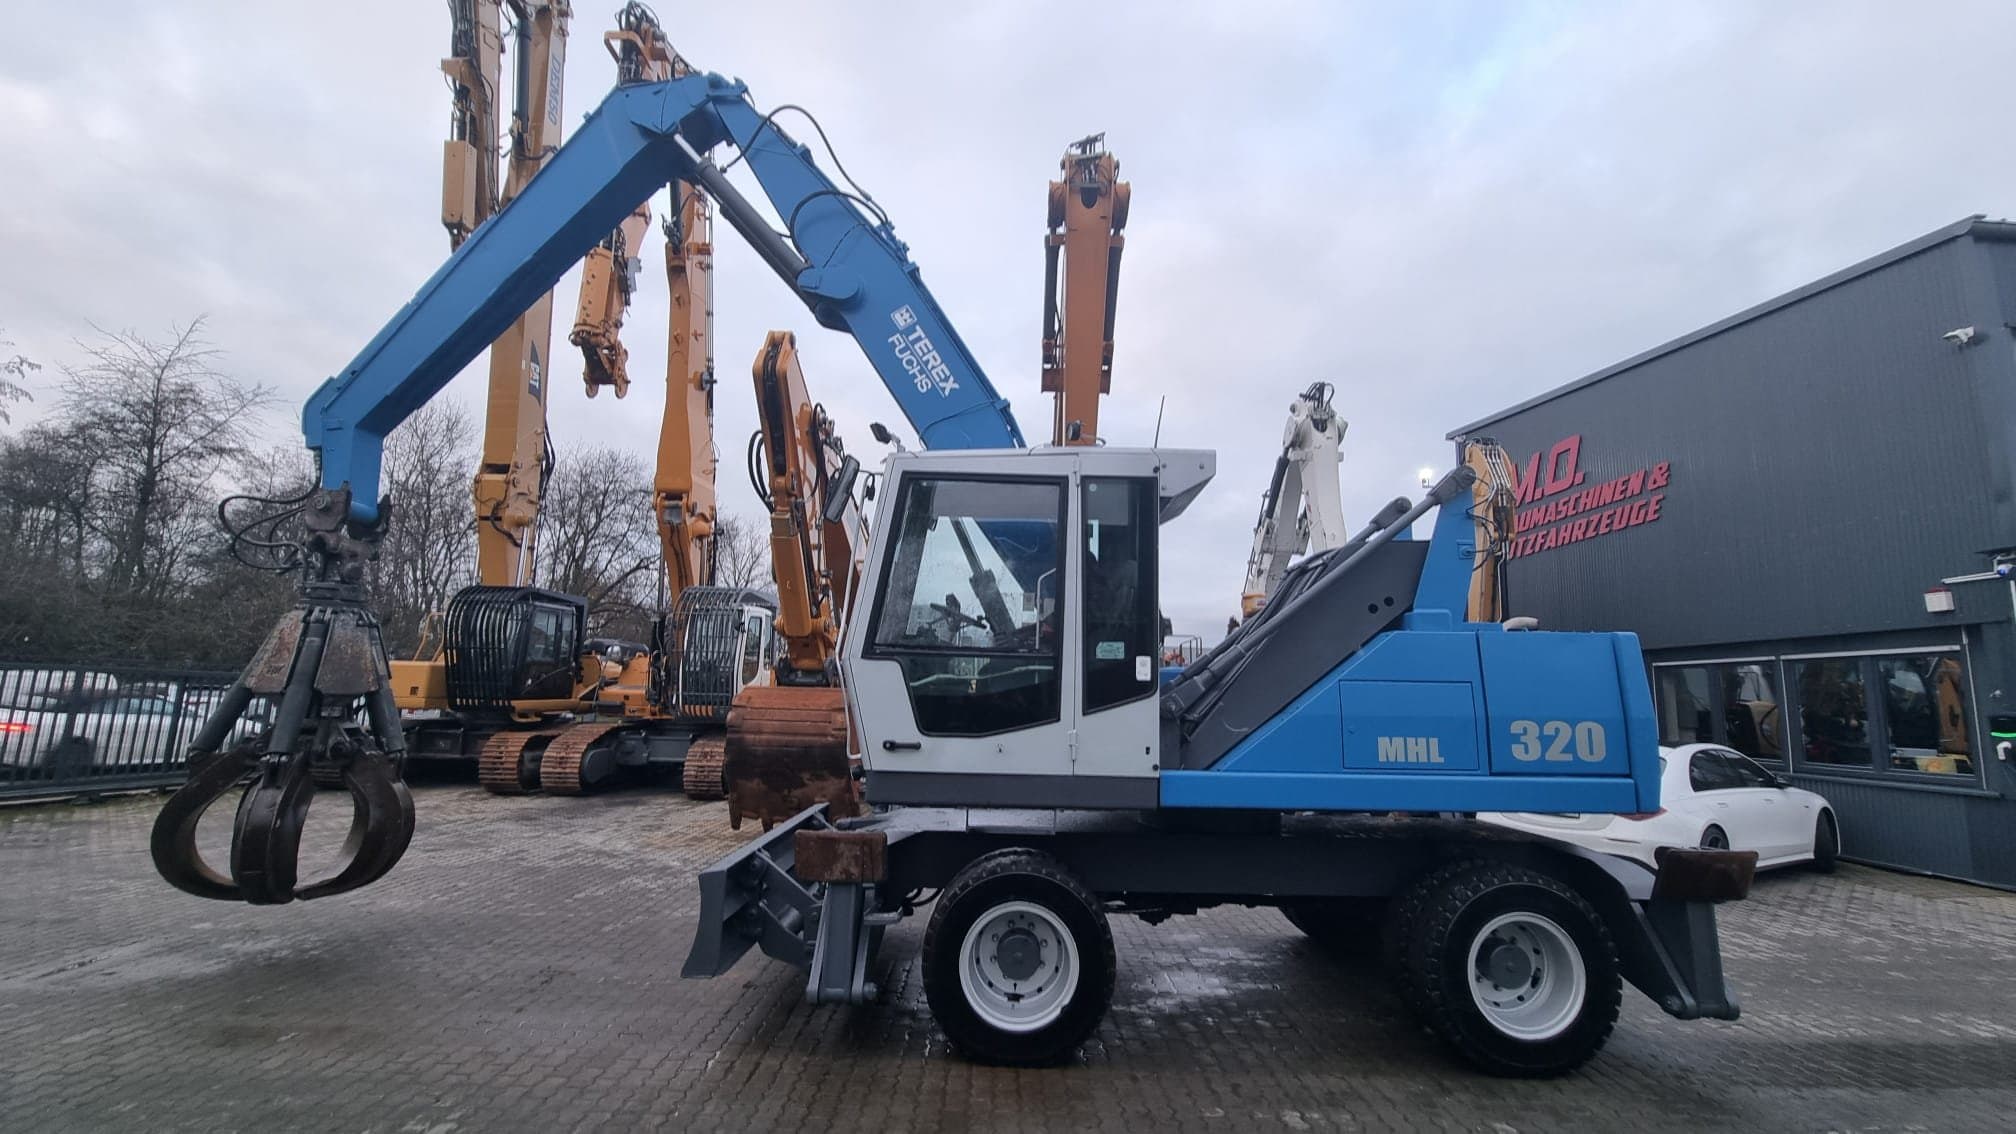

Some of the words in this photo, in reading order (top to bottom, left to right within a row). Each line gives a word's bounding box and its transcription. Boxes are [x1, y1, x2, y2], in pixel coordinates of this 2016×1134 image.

[529, 362, 541, 389] CAT
[888, 333, 932, 394] FUCHS
[908, 324, 960, 397] TEREX
[1509, 494, 1664, 560] TZFAHRZEUGE
[1514, 468, 1647, 534] UMASCHINEN
[1647, 461, 1670, 491] &
[1377, 736, 1445, 763] MHL
[1510, 720, 1606, 762] 320
